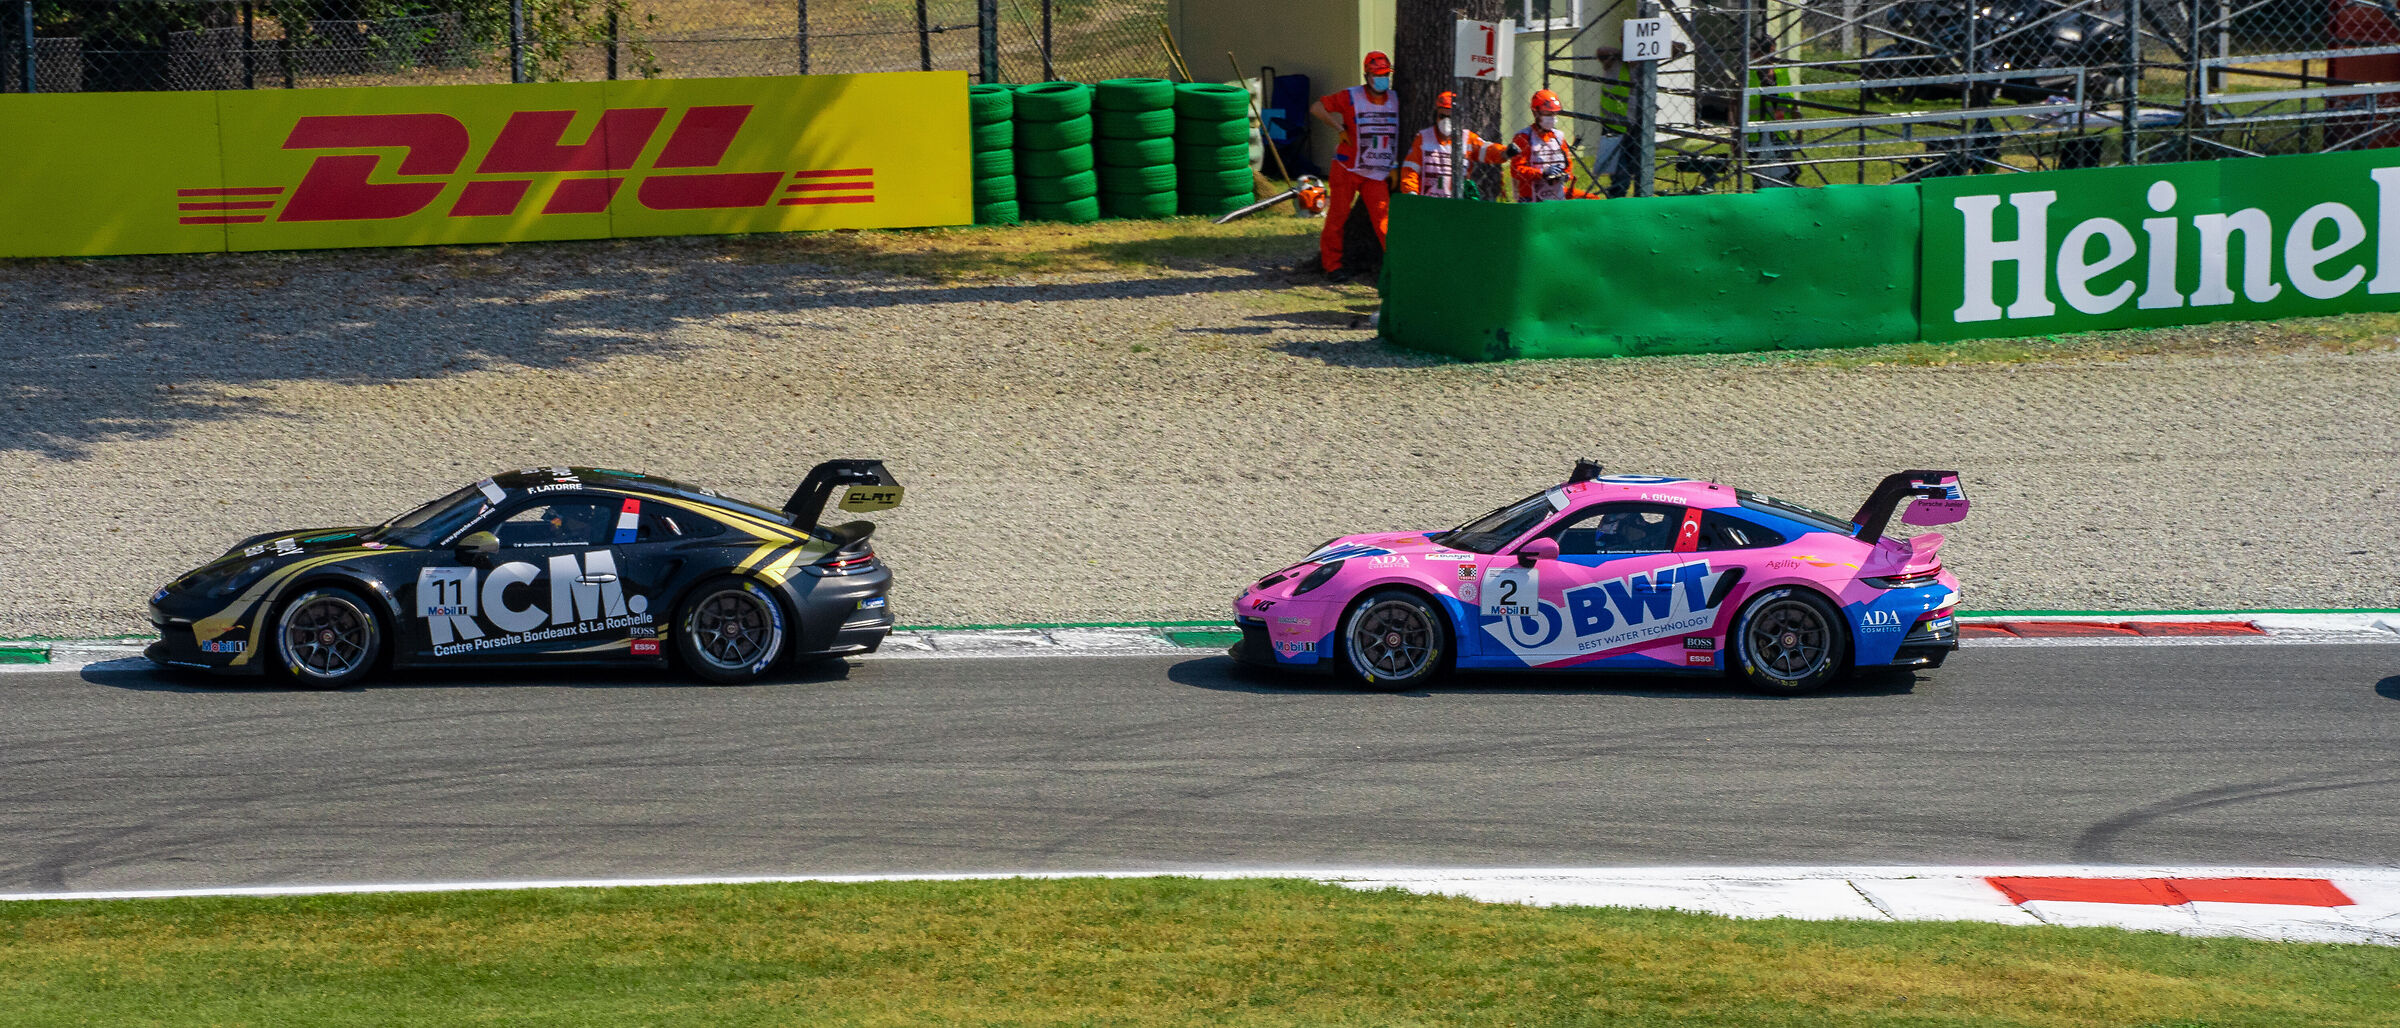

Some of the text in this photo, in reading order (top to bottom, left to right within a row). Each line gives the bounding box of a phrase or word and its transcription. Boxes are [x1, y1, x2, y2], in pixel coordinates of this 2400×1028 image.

[1636, 22, 1660, 37] MP
[1637, 41, 1659, 56] 2.0
[1471, 54, 1495, 65] FIRE
[276, 104, 785, 223] DHL
[527, 483, 583, 495] F. LATORRE
[1652, 493, 1687, 505] GÜVEN
[1369, 555, 1410, 564] ADA
[1765, 559, 1801, 569] Agility
[432, 579, 462, 605] 11
[1499, 579, 1517, 606] 2
[1567, 562, 1709, 638] BWT
[428, 606, 456, 616] Mobil
[1491, 606, 1518, 615] Mobil
[1861, 610, 1901, 625] ADA
[434, 613, 653, 657] Centre Porsche Bordeaux & La Rochelle
[630, 626, 655, 635] BOSS
[1578, 615, 1709, 651] BEST WATER TECHNOLOGY
[202, 640, 234, 652] Mobil
[1275, 641, 1304, 651] Mobil
[1687, 638, 1712, 646] BOSS
